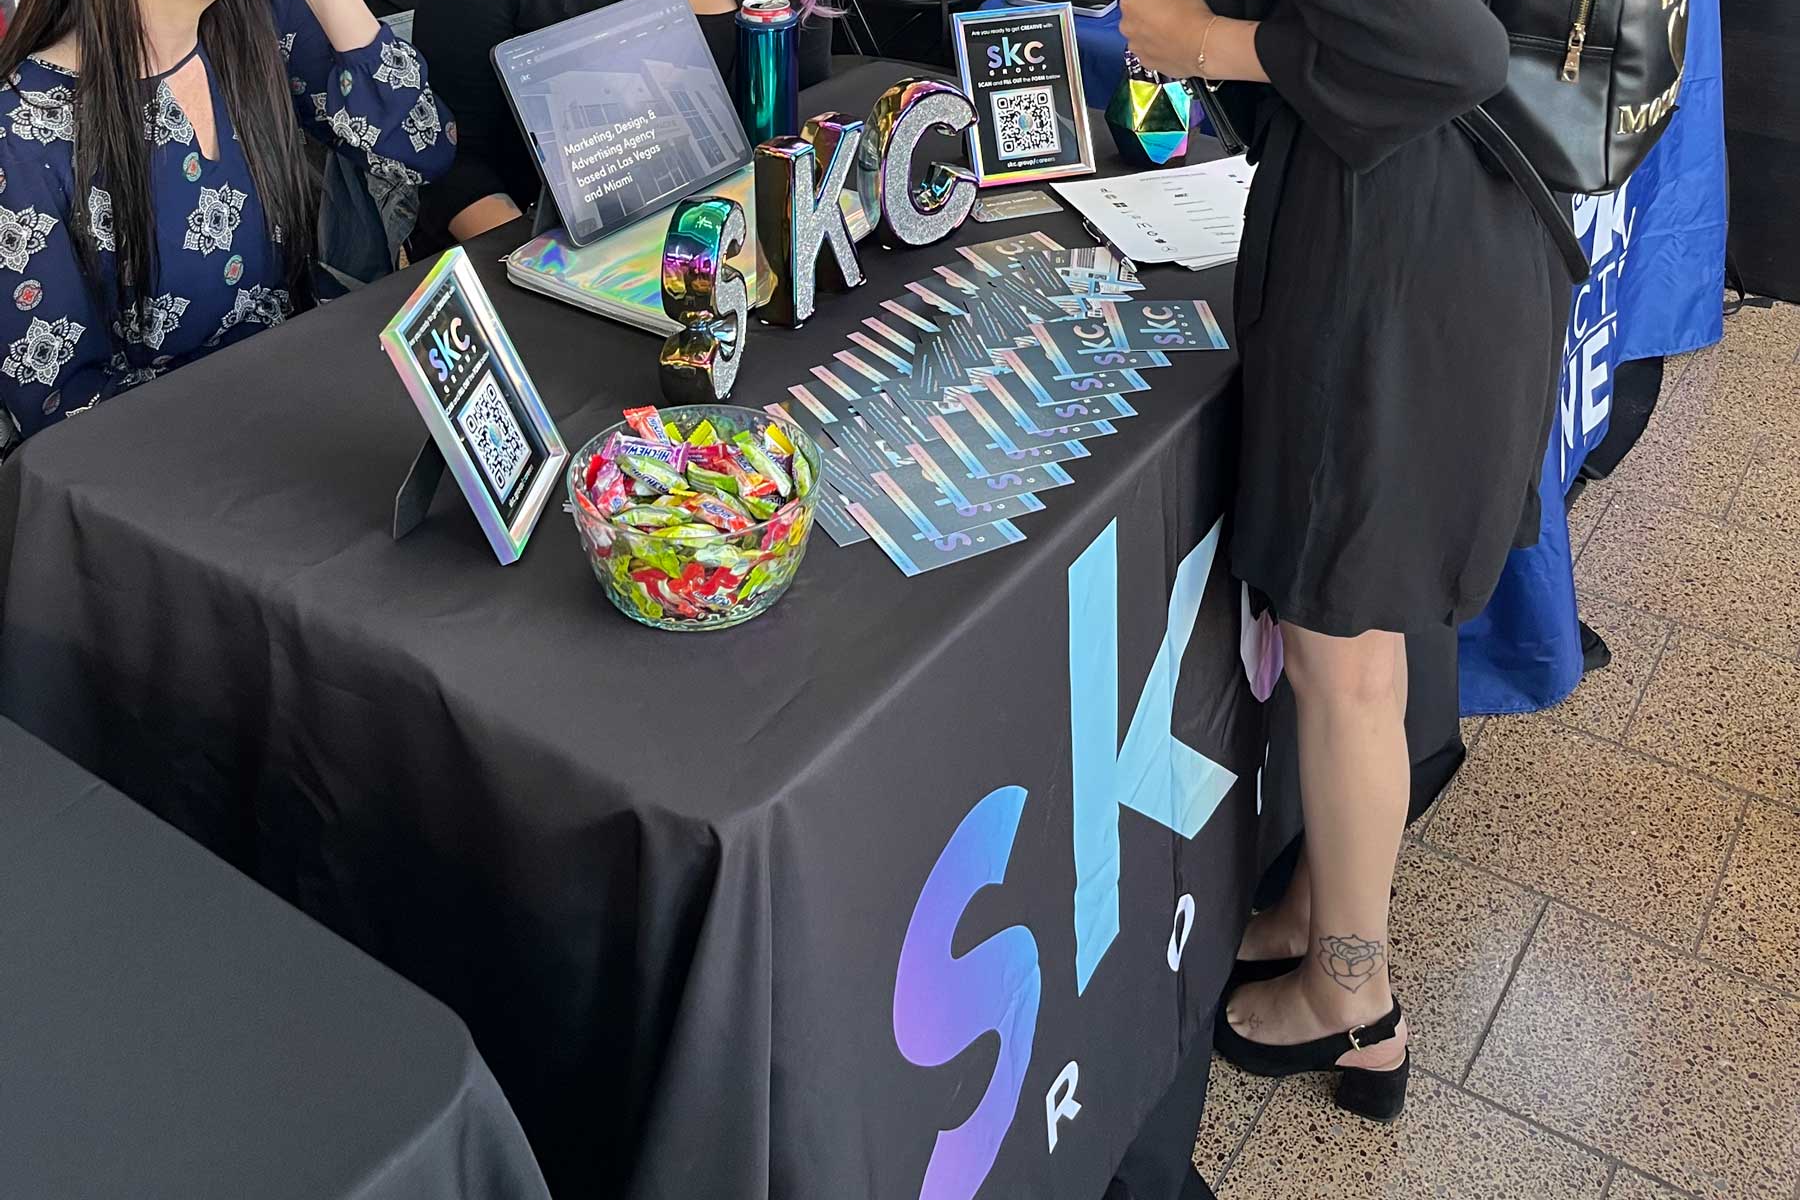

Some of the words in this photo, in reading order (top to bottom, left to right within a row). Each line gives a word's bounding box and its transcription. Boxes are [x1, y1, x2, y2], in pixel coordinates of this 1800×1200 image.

[989, 64, 1047, 77] GROUP
[564, 130, 615, 156] Marketing,
[614, 115, 649, 134] Design,
[647, 109, 656, 120] &
[572, 144, 623, 172] Advertising
[624, 129, 656, 148] Agency
[576, 166, 607, 188] based
[606, 164, 617, 174] in
[617, 155, 634, 169] Las
[633, 144, 661, 161] Vegas
[584, 186, 604, 203] and
[603, 172, 633, 194] Miami
